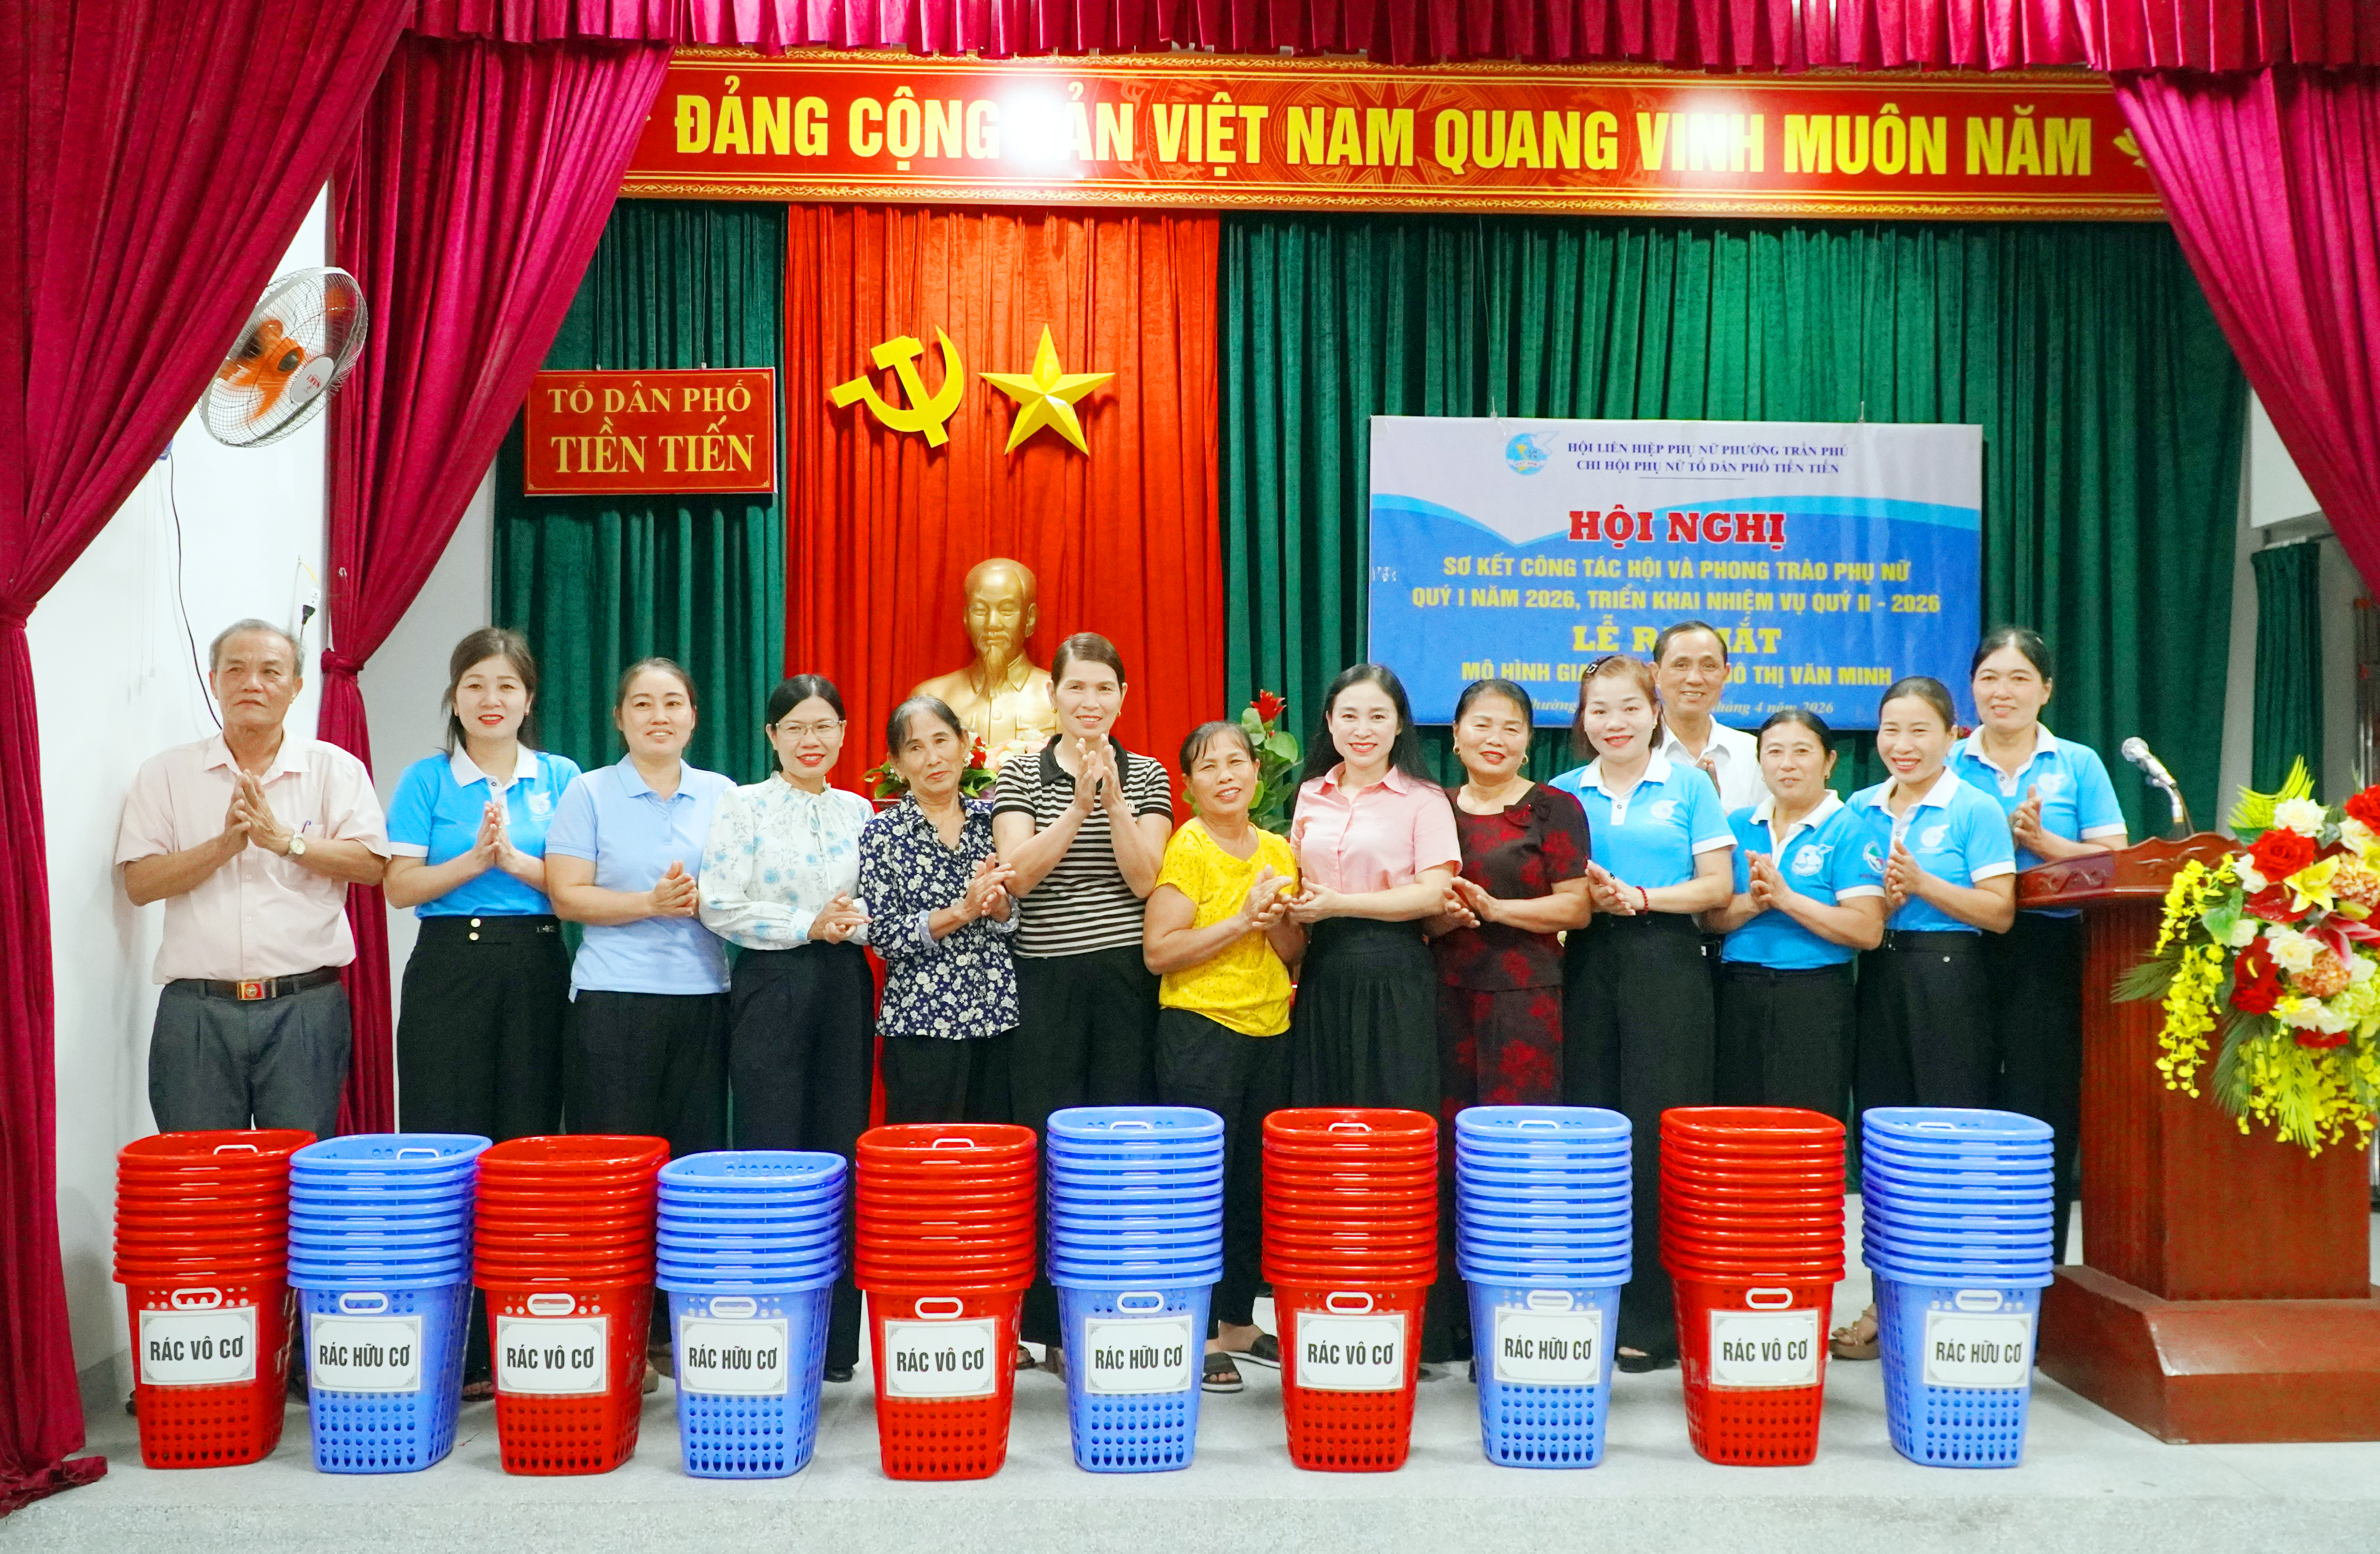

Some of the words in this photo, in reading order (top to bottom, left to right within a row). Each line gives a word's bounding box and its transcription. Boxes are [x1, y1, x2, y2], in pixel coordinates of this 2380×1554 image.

[675, 76, 828, 156] ĐẢNG
[849, 85, 1000, 171] CỘNG
[1057, 81, 1134, 162] ẢN
[1152, 92, 1269, 177] VIỆT
[1287, 107, 1414, 166] NAM
[1434, 108, 1618, 175] QUANG
[1636, 111, 1765, 172] VINH
[1783, 103, 1947, 175] MUÔN
[1966, 104, 2092, 176] NĂM
[547, 381, 593, 413] TỔ
[604, 380, 672, 413] DÂN
[682, 379, 751, 413] PHỐ
[551, 416, 648, 473] TIỀN
[658, 415, 755, 473] TIẾN
[1568, 441, 1593, 455] HỘI
[1597, 441, 1628, 453] LIÊN
[1632, 442, 1664, 456] HIỆP
[1667, 445, 1695, 457] PHỤ
[1699, 443, 1719, 455] NỮ
[1821, 444, 1848, 456] PHÚ
[1577, 460, 1600, 470] CHI
[1605, 459, 1630, 473] HỘI
[1634, 461, 1661, 474] PHỤ
[1665, 460, 1685, 471] NỮ
[1710, 460, 1737, 473] DÂN
[1569, 504, 1654, 549] HỘI
[1667, 511, 1786, 551] NGHỊ
[1443, 556, 1472, 576] SƠ
[1477, 552, 1515, 577] KẾT
[1521, 555, 1576, 577] CÔNG
[1582, 555, 1621, 578] TÁC
[1628, 556, 1662, 582] HỘI
[1668, 556, 1694, 579] VÀ
[1700, 561, 1770, 580] PHONG
[1776, 558, 1828, 581] TRÀO
[1834, 562, 1875, 584] PHỤ
[1881, 559, 1911, 581] NỮ
[1412, 584, 1452, 608] QUÝ
[1458, 588, 1465, 607] I
[1471, 585, 1519, 608] NĂM
[1525, 590, 1581, 610] 2026,
[1587, 583, 1646, 609] TRIỂN
[1653, 591, 1700, 609] KHAI
[1706, 588, 1774, 615] NHIỆM
[1779, 593, 1806, 615] VỤ
[1812, 589, 1851, 613] QUÝ
[1858, 594, 1871, 612] II
[1891, 594, 1941, 613] 2026
[1573, 614, 1619, 652] LỄ
[1632, 626, 1671, 652] R
[1462, 659, 1494, 681] MÔ
[1501, 659, 1550, 681] HÌNH
[1752, 666, 1784, 688] THỊ
[1790, 664, 1832, 685] VĂN
[1837, 667, 1892, 685] MINH
[1754, 701, 1763, 713] 4
[150, 1337, 184, 1361] RÁC
[191, 1336, 213, 1360] VÔ
[219, 1335, 244, 1358] CƠ
[320, 1341, 348, 1367] RÁC
[353, 1343, 384, 1367] HỮU
[389, 1344, 410, 1367] CƠ
[507, 1344, 538, 1369] RÁC
[544, 1345, 565, 1369] VÔ
[571, 1346, 594, 1369] CƠ
[689, 1344, 717, 1369] RÁC
[722, 1346, 751, 1370] HỮU
[757, 1347, 777, 1370] CƠ
[896, 1348, 929, 1372] RÁC
[934, 1347, 956, 1372] VÔ
[962, 1347, 984, 1371] CƠ
[1095, 1345, 1124, 1370] RÁC
[1130, 1345, 1159, 1369] HỮU
[1164, 1344, 1183, 1367] CƠ
[1308, 1340, 1340, 1365] RÁC
[1345, 1341, 1366, 1365] VÔ
[1372, 1342, 1394, 1365] CƠ
[1505, 1335, 1533, 1359] RÁC
[1539, 1337, 1568, 1360] HỮU
[1573, 1338, 1592, 1360] CƠ
[1723, 1338, 1755, 1362] RÁC
[1762, 1338, 1782, 1361] VÔ
[1787, 1338, 1808, 1361] CƠ
[1936, 1338, 1966, 1362] RÁC
[1971, 1340, 2000, 1363] HỮU
[2004, 1342, 2022, 1363] CƠ
